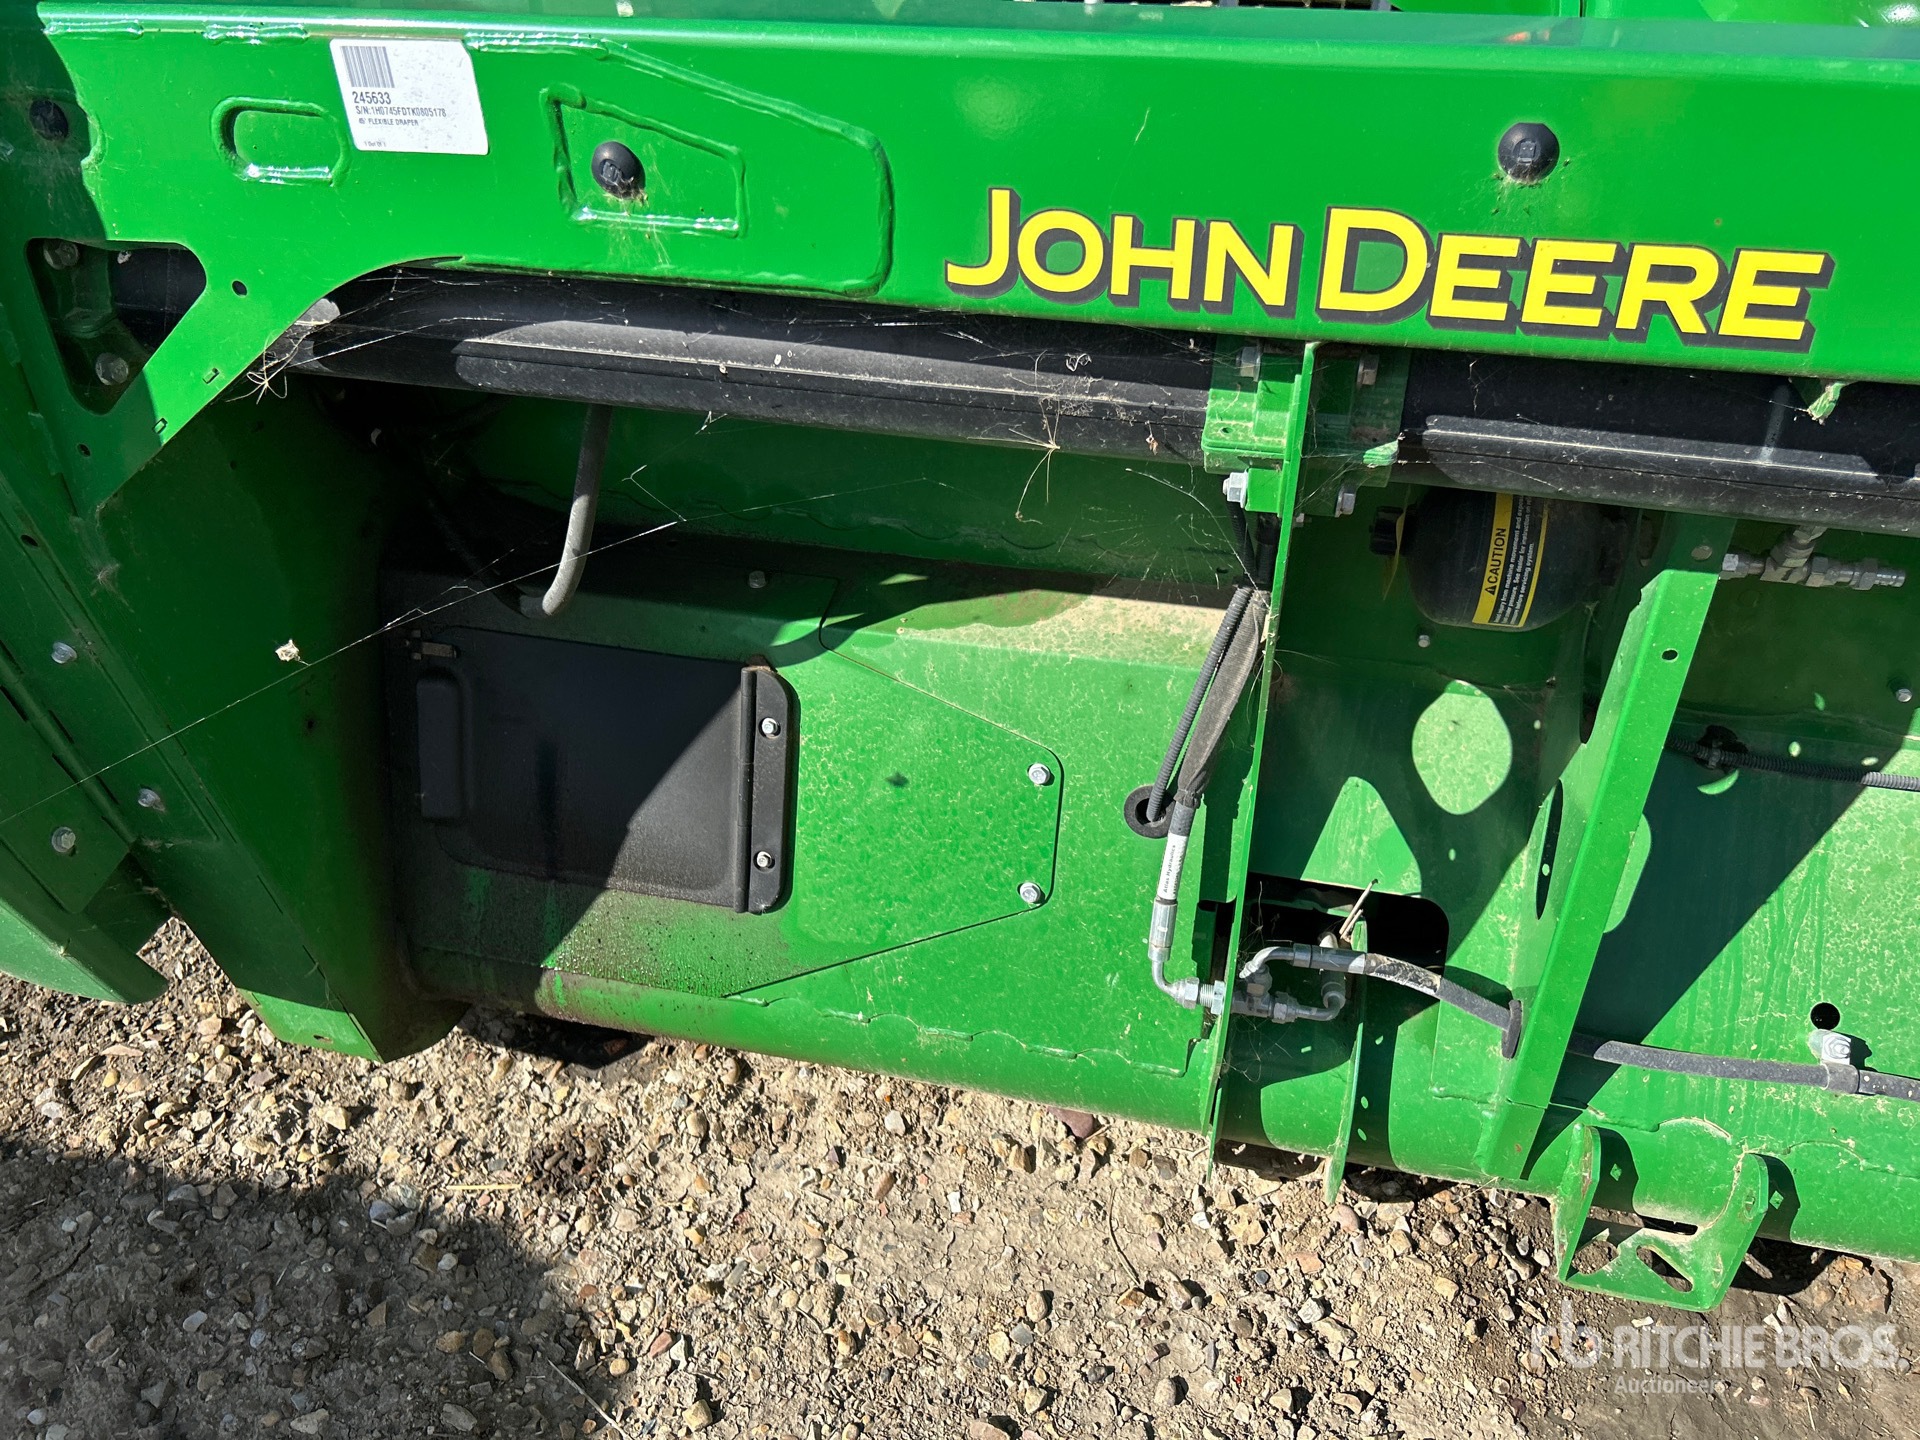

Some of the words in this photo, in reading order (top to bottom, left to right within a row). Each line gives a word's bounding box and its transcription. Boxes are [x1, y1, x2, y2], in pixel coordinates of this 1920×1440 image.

[352, 91, 391, 104] 245633
[945, 187, 1304, 319] JOHN
[1316, 206, 1835, 353] DEERE
[1487, 528, 1506, 584] CAUTION
[1505, 563, 1515, 589] machine
[1510, 530, 1520, 562] movement
[1516, 555, 1524, 573] dealer
[1522, 514, 1530, 545] instruction
[1520, 567, 1532, 594] servicing
[1526, 543, 1534, 566] system.
[1166, 845, 1176, 876] Hydraulics
